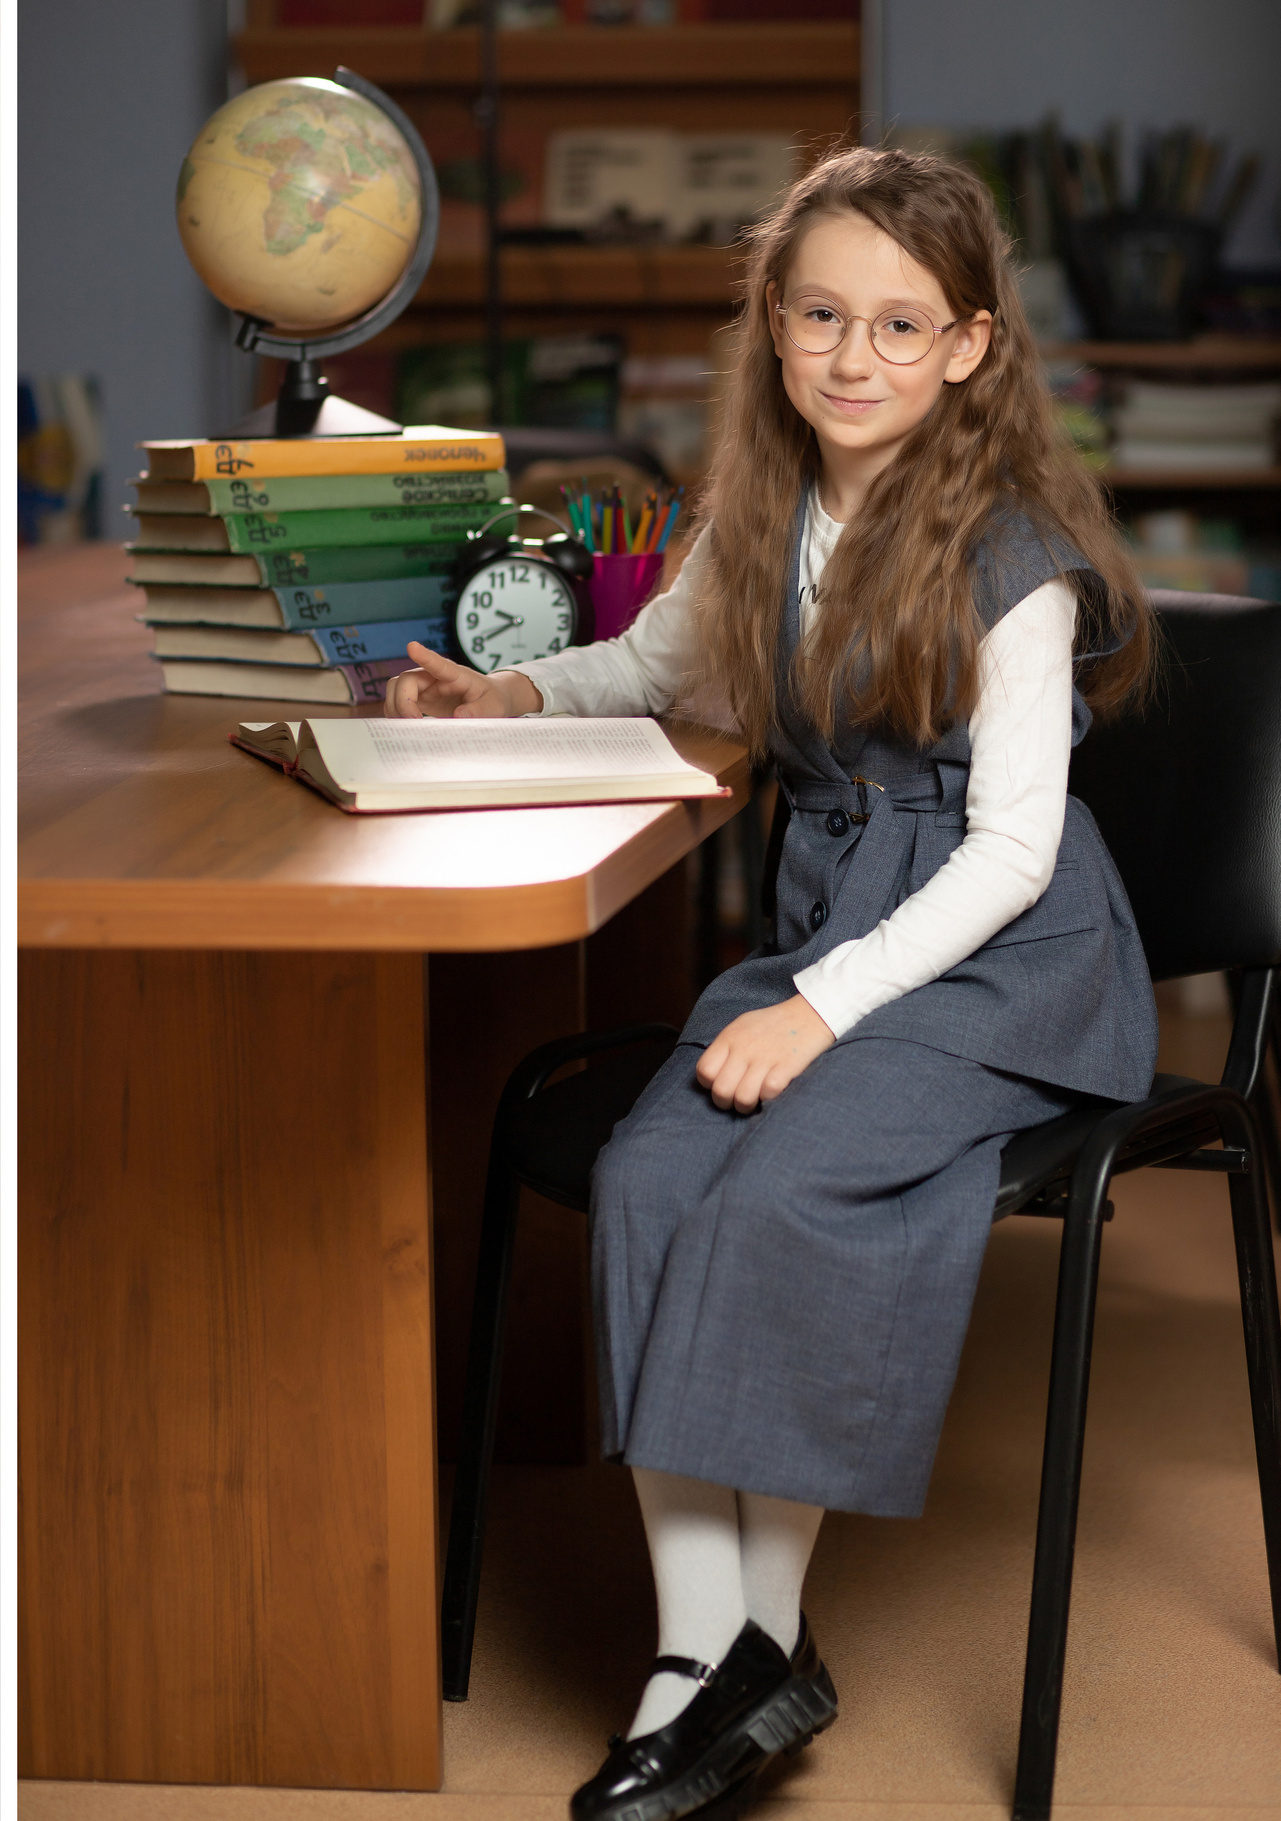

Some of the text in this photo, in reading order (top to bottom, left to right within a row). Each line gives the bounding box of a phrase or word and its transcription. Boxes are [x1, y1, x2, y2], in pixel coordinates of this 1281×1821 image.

[215, 445, 236, 475] ДЭ
[404, 446, 487, 462] Человек
[230, 481, 253, 511] ДЭ
[252, 493, 269, 506] 6
[244, 514, 270, 544] ДЭ
[269, 526, 287, 538] 5
[273, 553, 295, 584] ДЭ
[509, 565, 530, 583] 12
[488, 571, 505, 589] 11
[538, 572, 547, 589] 1
[294, 591, 317, 621] ДЭ
[471, 591, 493, 609] 10
[552, 588, 566, 607] 2
[317, 602, 331, 615] 3
[466, 612, 479, 630] 9
[557, 613, 570, 631] 3
[330, 631, 355, 659] ДЭ
[352, 643, 367, 655] 2
[471, 636, 485, 654] 8
[547, 636, 562, 654] 4
[488, 653, 502, 670] 7
[354, 663, 381, 698] ДЭ
